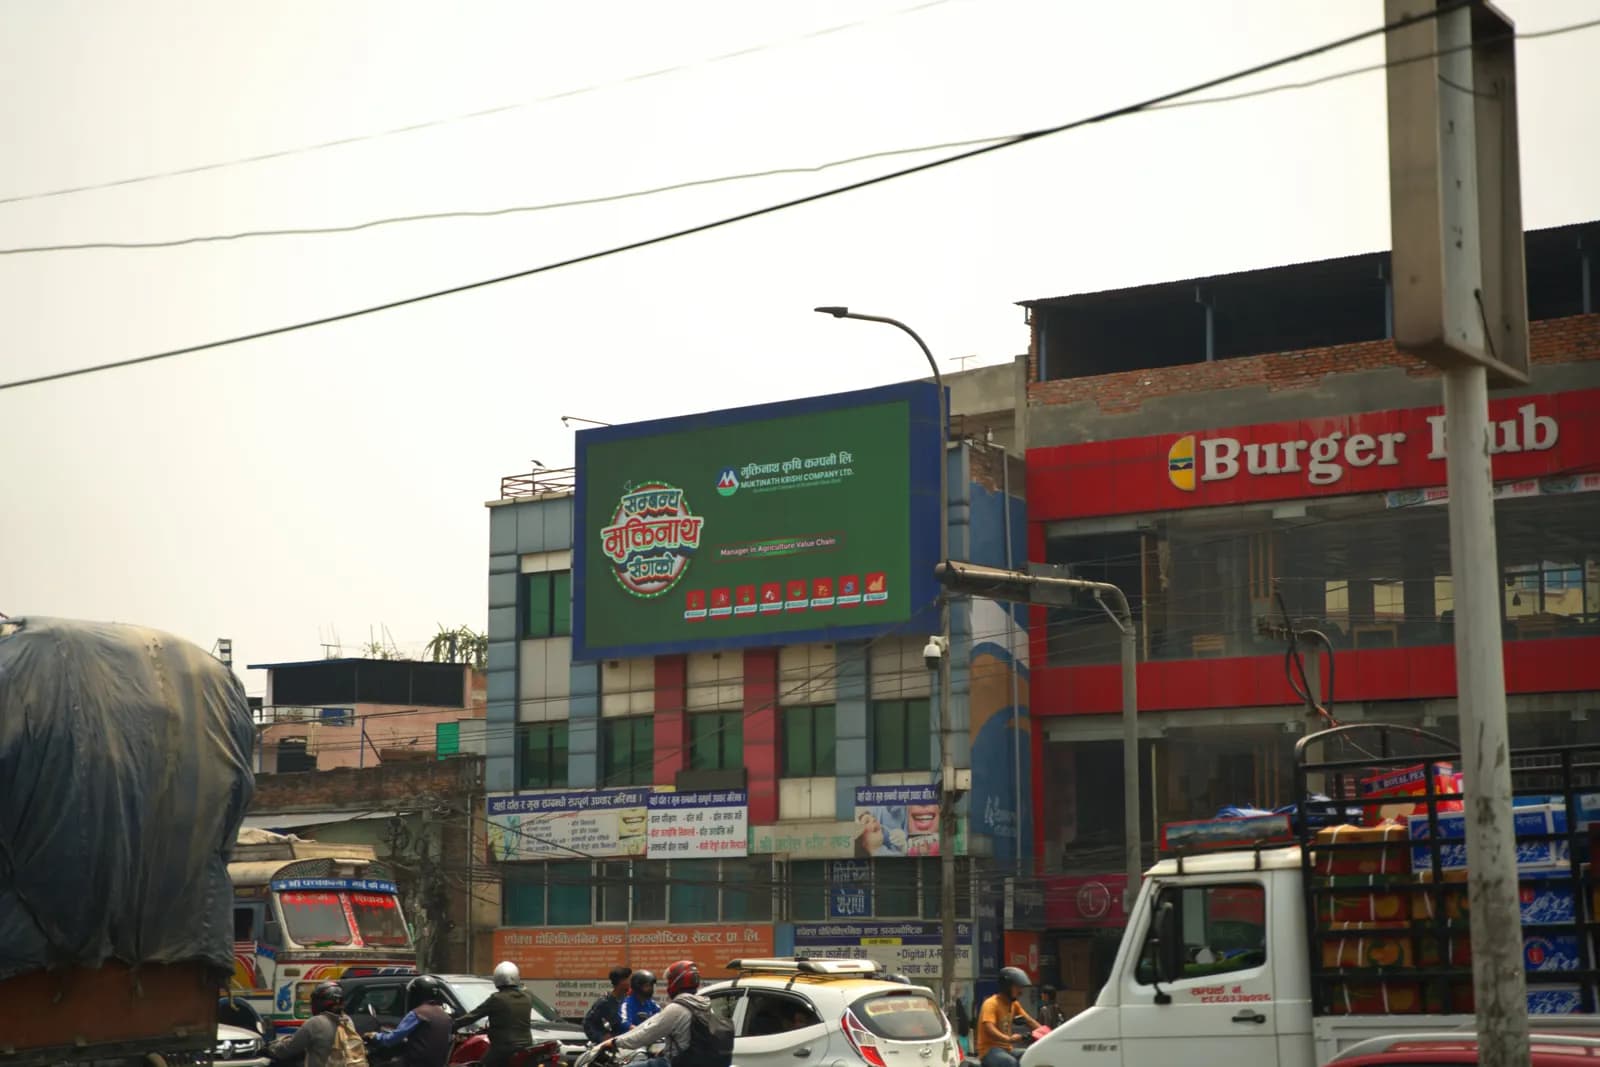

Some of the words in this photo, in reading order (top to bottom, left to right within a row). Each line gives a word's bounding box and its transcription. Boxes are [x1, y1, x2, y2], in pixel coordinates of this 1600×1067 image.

[740, 462, 780, 479] मुक्तिनाथ
[782, 457, 802, 473] कृषि
[804, 453, 837, 468] कम्पनी
[1200, 431, 1406, 485] Burger
[740, 477, 780, 488] MUKTINATH
[781, 475, 803, 485] KRISHI
[803, 470, 838, 481] COMPANY
[601, 516, 704, 562] मुक्तिनाथ
[721, 547, 749, 556] Manager
[758, 542, 795, 553] Agriculture
[796, 540, 815, 548] Value
[816, 538, 836, 546] Chain
[902, 949, 926, 960] Digital
